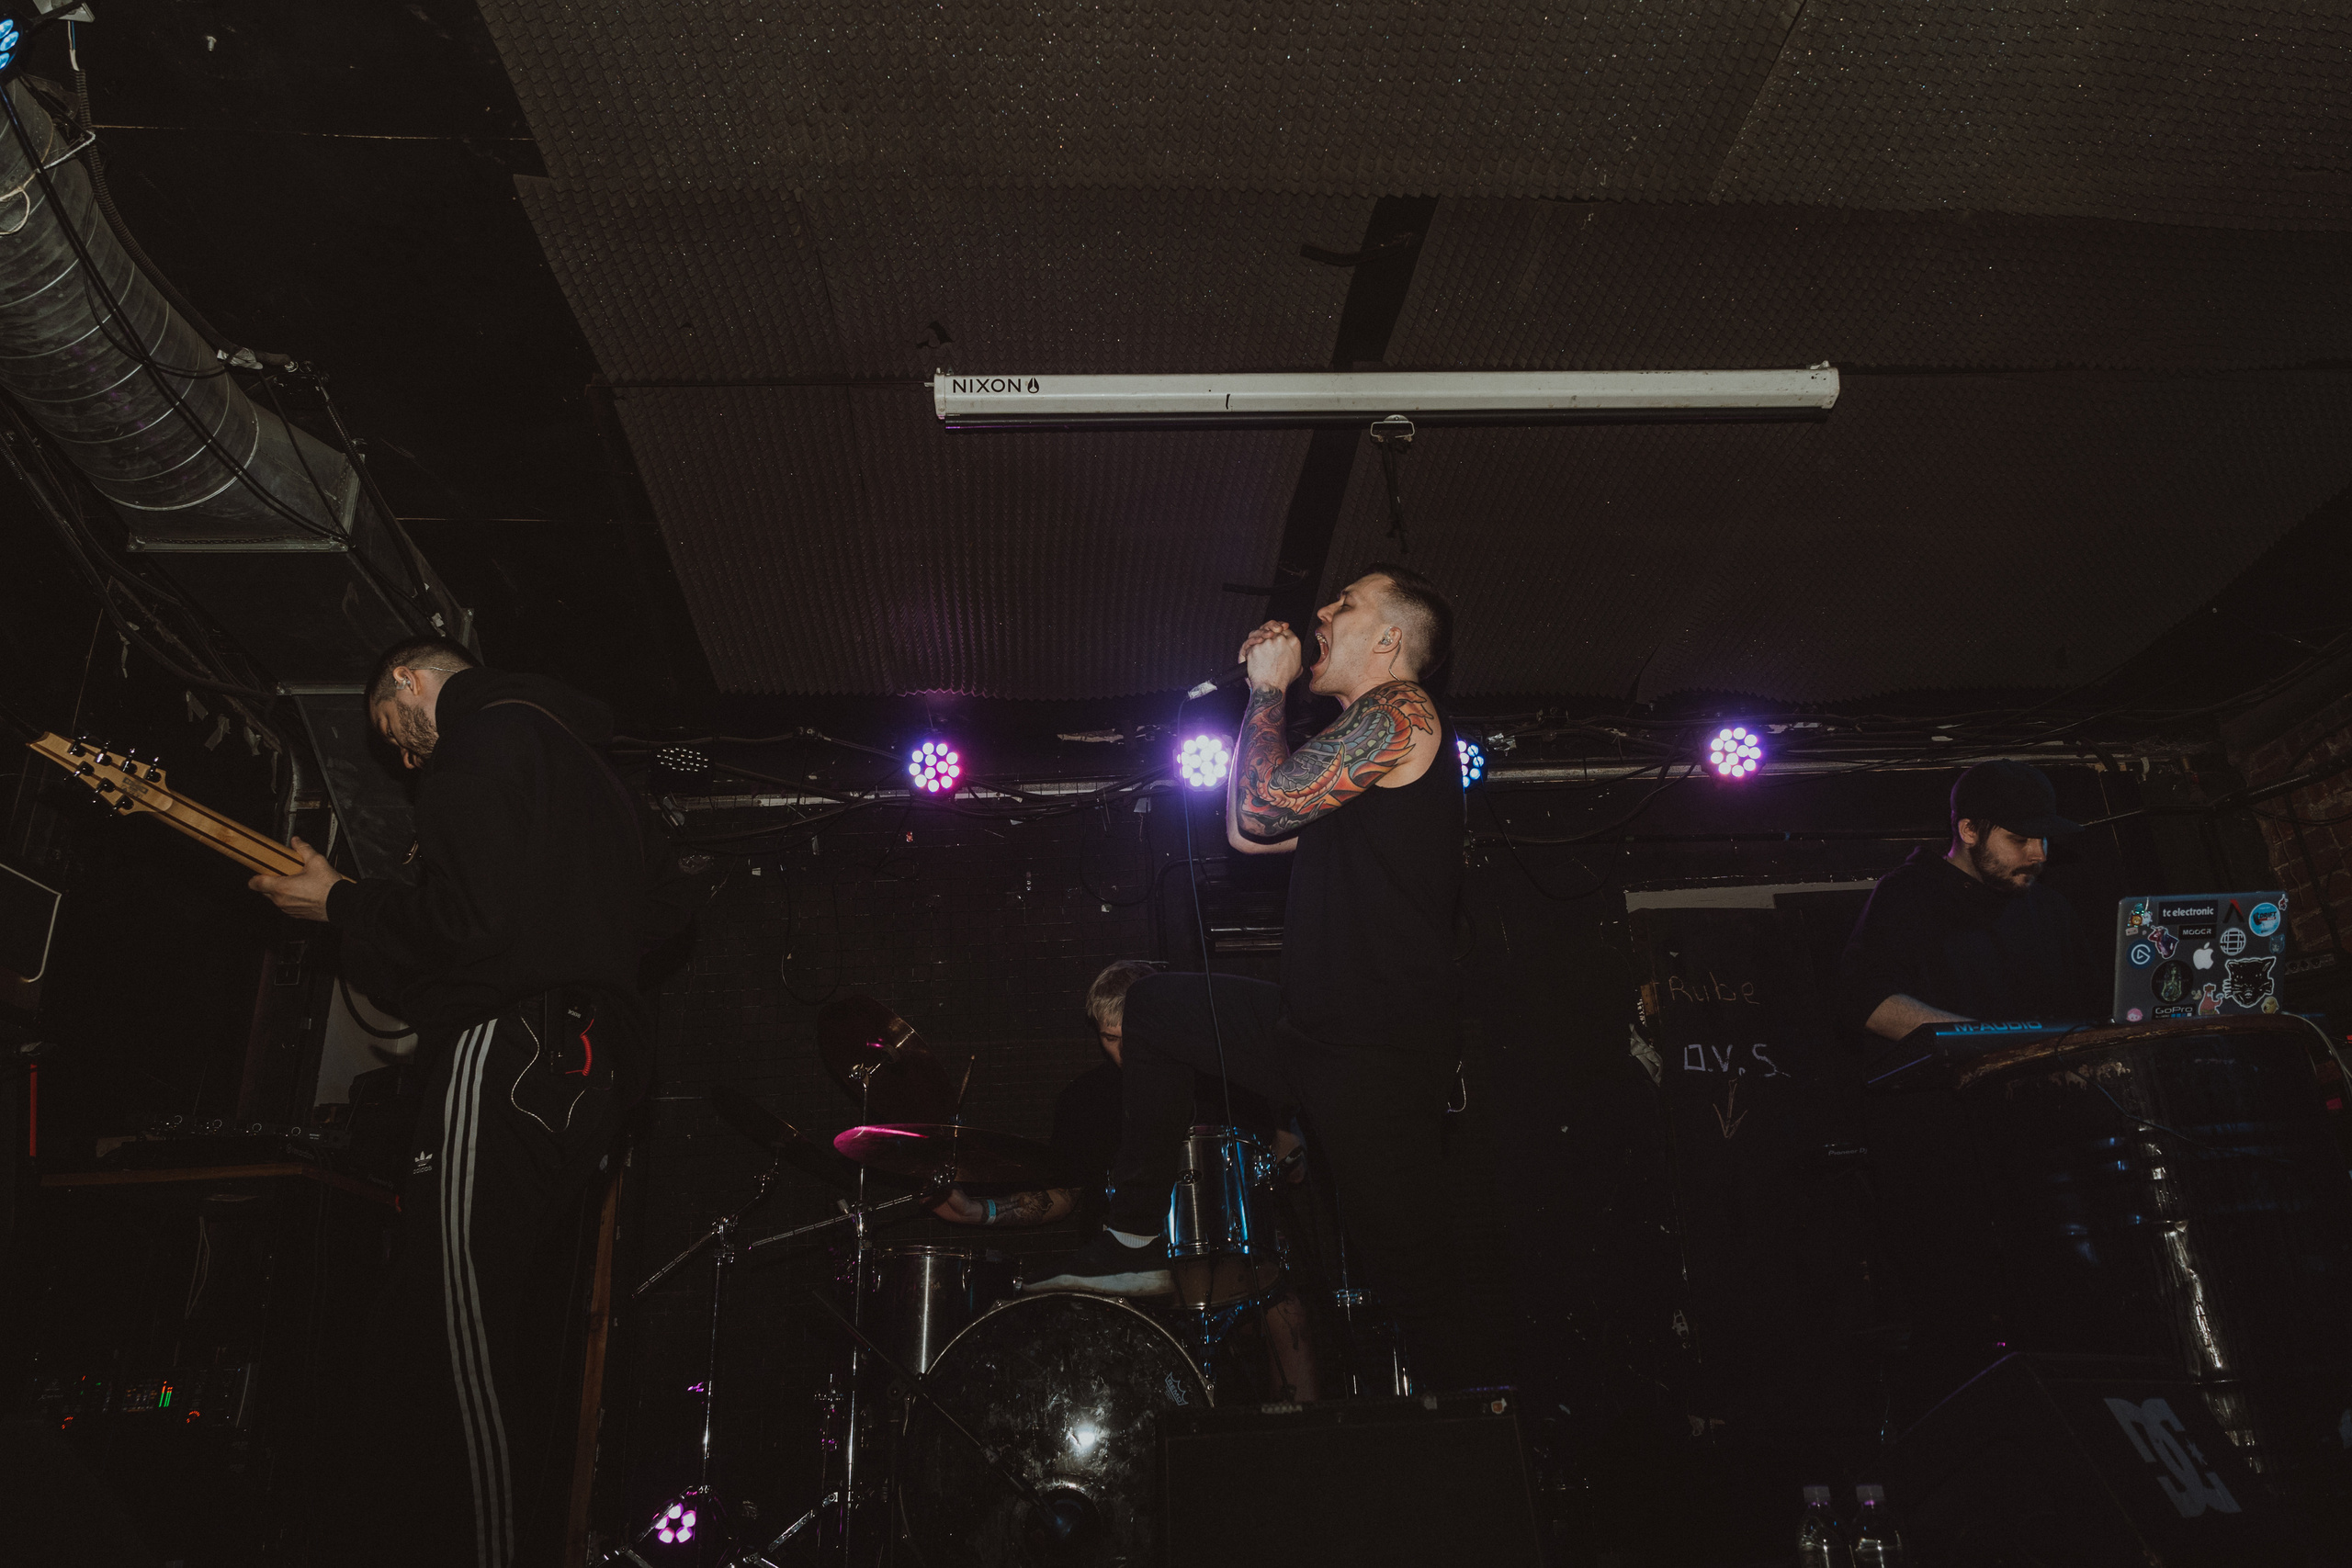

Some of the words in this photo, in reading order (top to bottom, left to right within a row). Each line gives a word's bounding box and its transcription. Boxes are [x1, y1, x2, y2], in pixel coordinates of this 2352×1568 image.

[953, 378, 1022, 393] NIXON
[2162, 908, 2172, 918] tc
[2172, 906, 2214, 917] electronic
[1668, 971, 1760, 1005] Rube
[2154, 1006, 2193, 1014] GoPro
[1953, 1021, 2042, 1032] M-AUDIO
[413, 1166, 433, 1175] adidas
[1167, 1378, 1182, 1403] REMO
